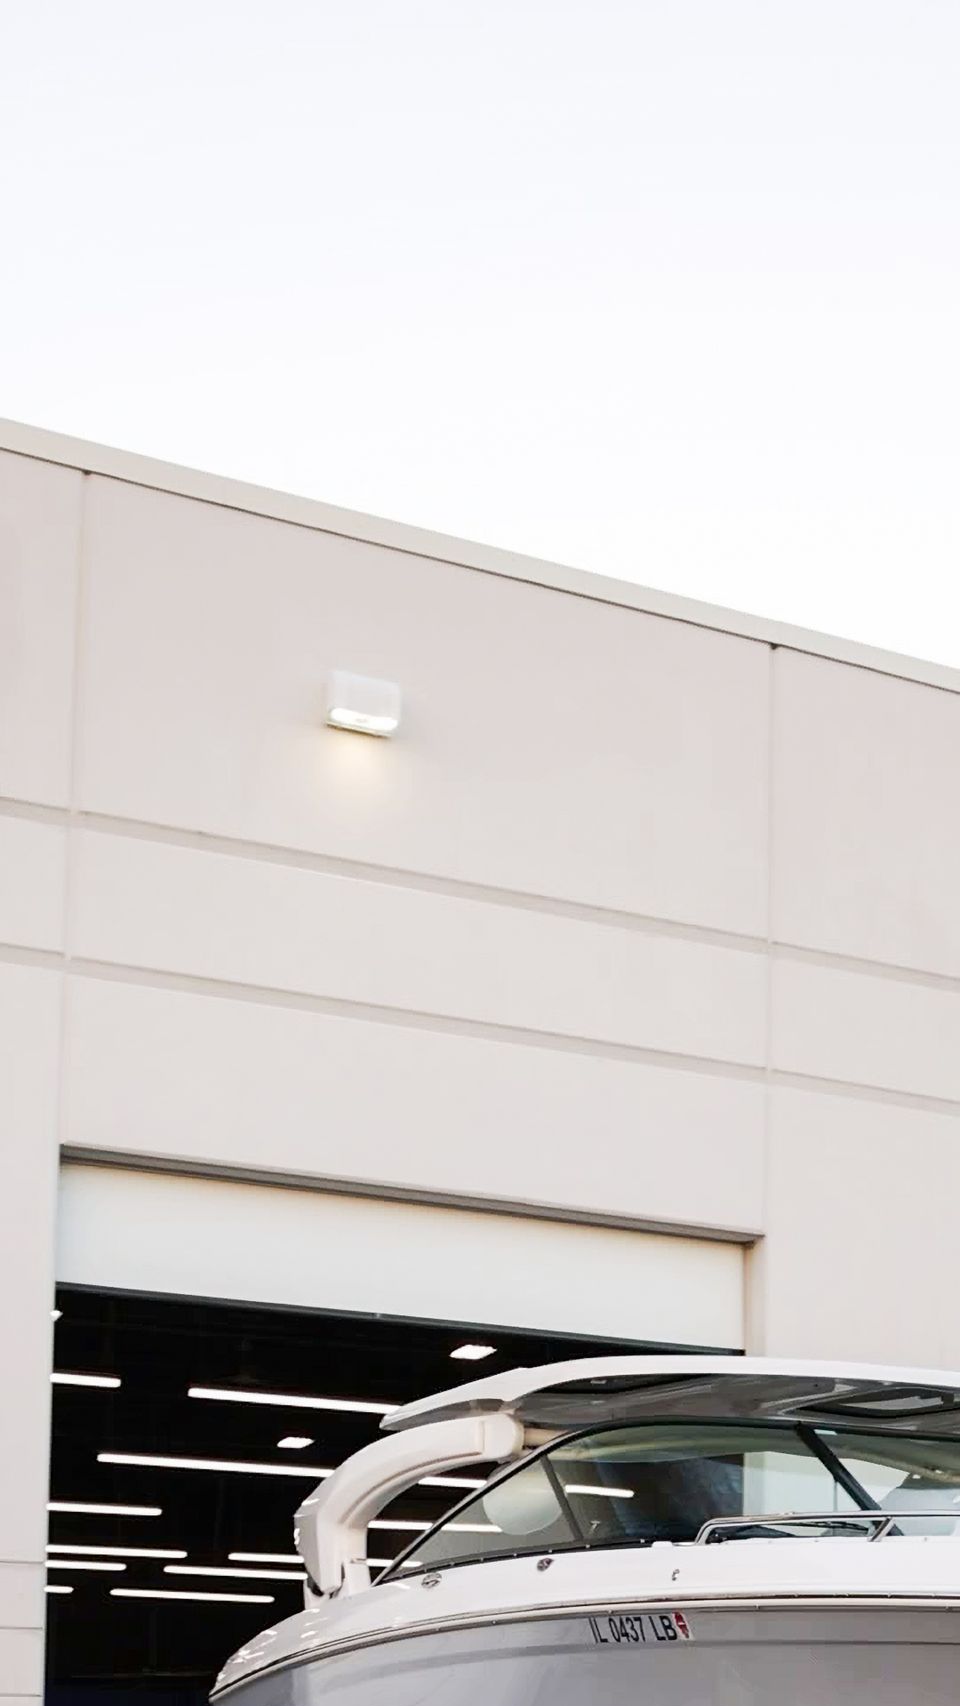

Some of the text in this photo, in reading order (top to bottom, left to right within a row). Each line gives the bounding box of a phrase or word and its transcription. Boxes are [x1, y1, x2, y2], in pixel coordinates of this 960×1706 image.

[588, 1614, 678, 1644] IL 0437 LB
